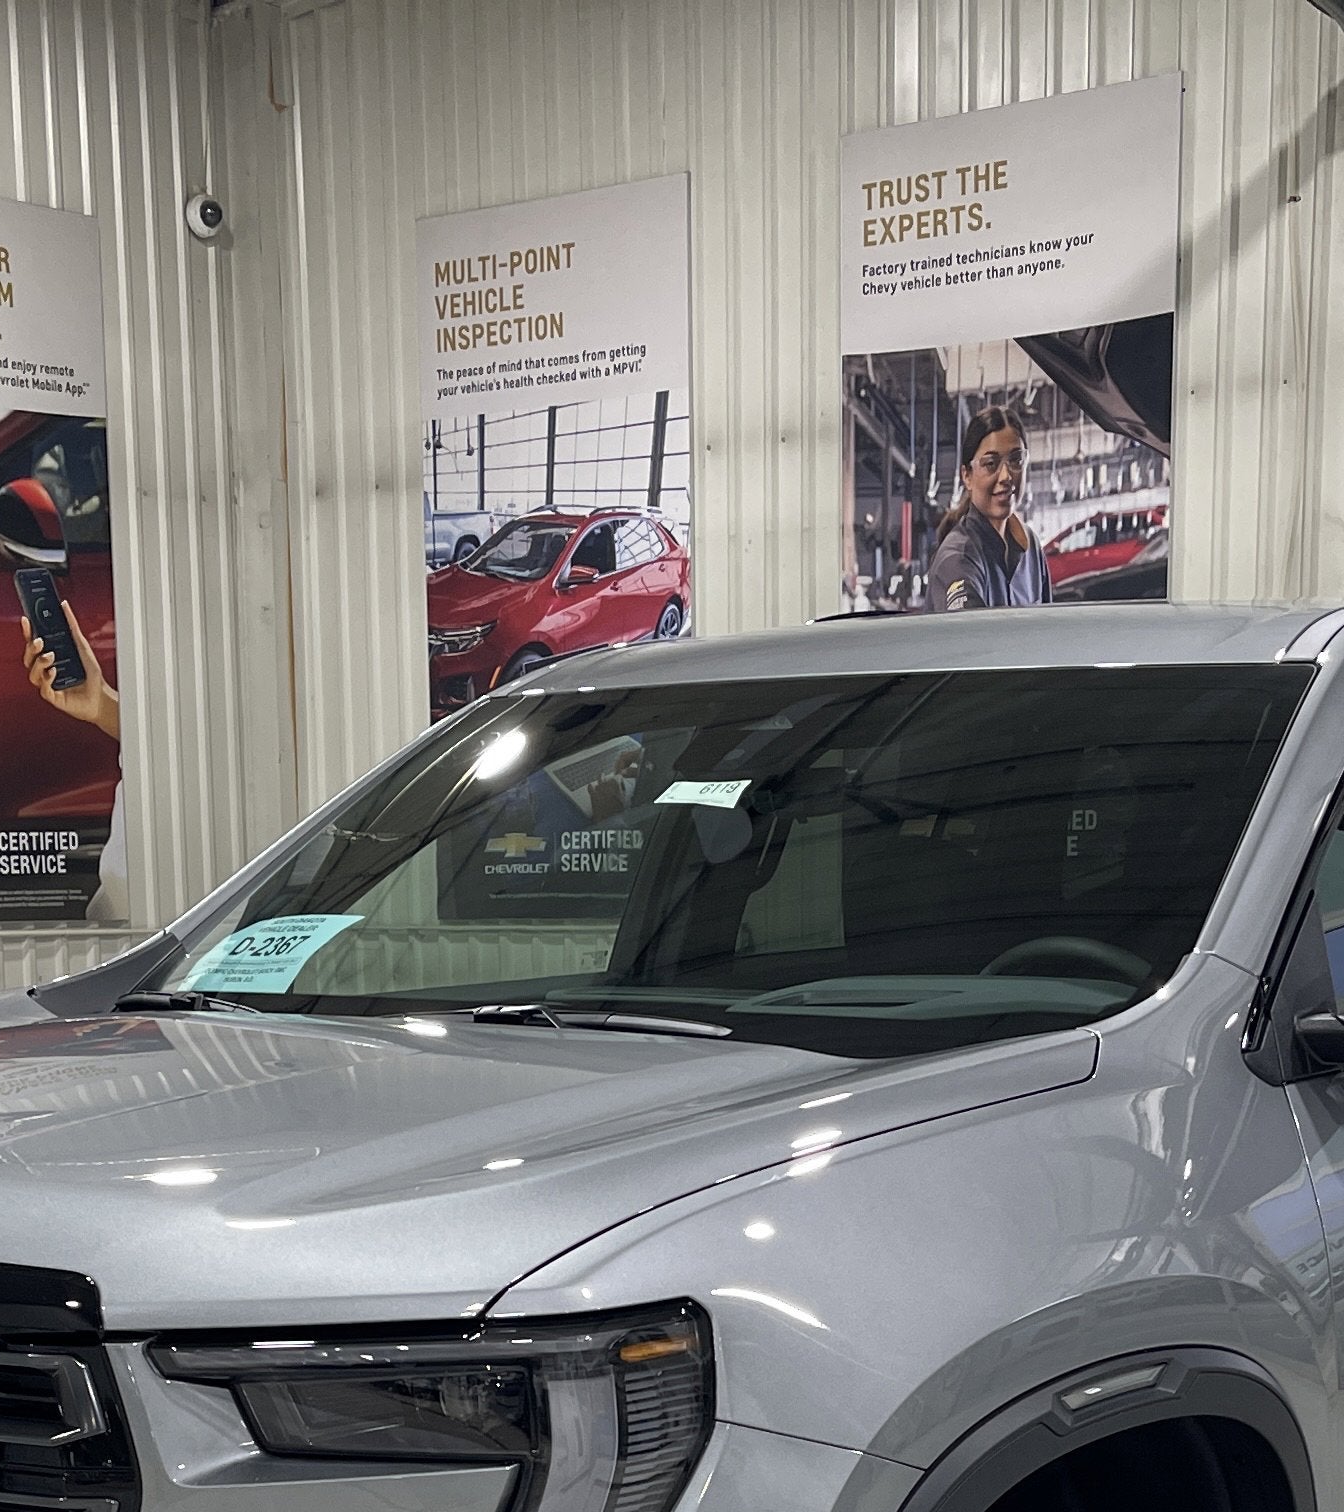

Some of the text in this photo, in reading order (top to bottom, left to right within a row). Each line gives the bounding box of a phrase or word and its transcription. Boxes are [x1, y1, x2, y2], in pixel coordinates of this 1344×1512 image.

[861, 160, 1009, 211] TRUST THE
[863, 202, 992, 247] EXPERTS.
[434, 242, 575, 288] MULTI-POINT
[862, 233, 1095, 278] Factory trained technicians know your
[862, 257, 1065, 296] Chevy vehicle better than anyone.
[434, 284, 524, 320] VEHICLE
[437, 312, 564, 353] INSPECTION
[11, 360, 38, 376] enjoy
[40, 363, 75, 377] remote
[437, 344, 647, 381] The peace of mind that comes from getting
[32, 378, 63, 393] Mobile
[437, 386, 457, 400] your
[460, 379, 501, 395] vehicle's
[503, 375, 534, 389] health
[536, 371, 577, 386] checked
[579, 366, 602, 380] with
[604, 367, 610, 377] a
[561, 830, 644, 850] CERTIFIED
[0, 854, 67, 875] SERVICE
[485, 863, 550, 875] CHEVROLET
[561, 853, 628, 872] SERVICE
[229, 935, 311, 957] D-2367
